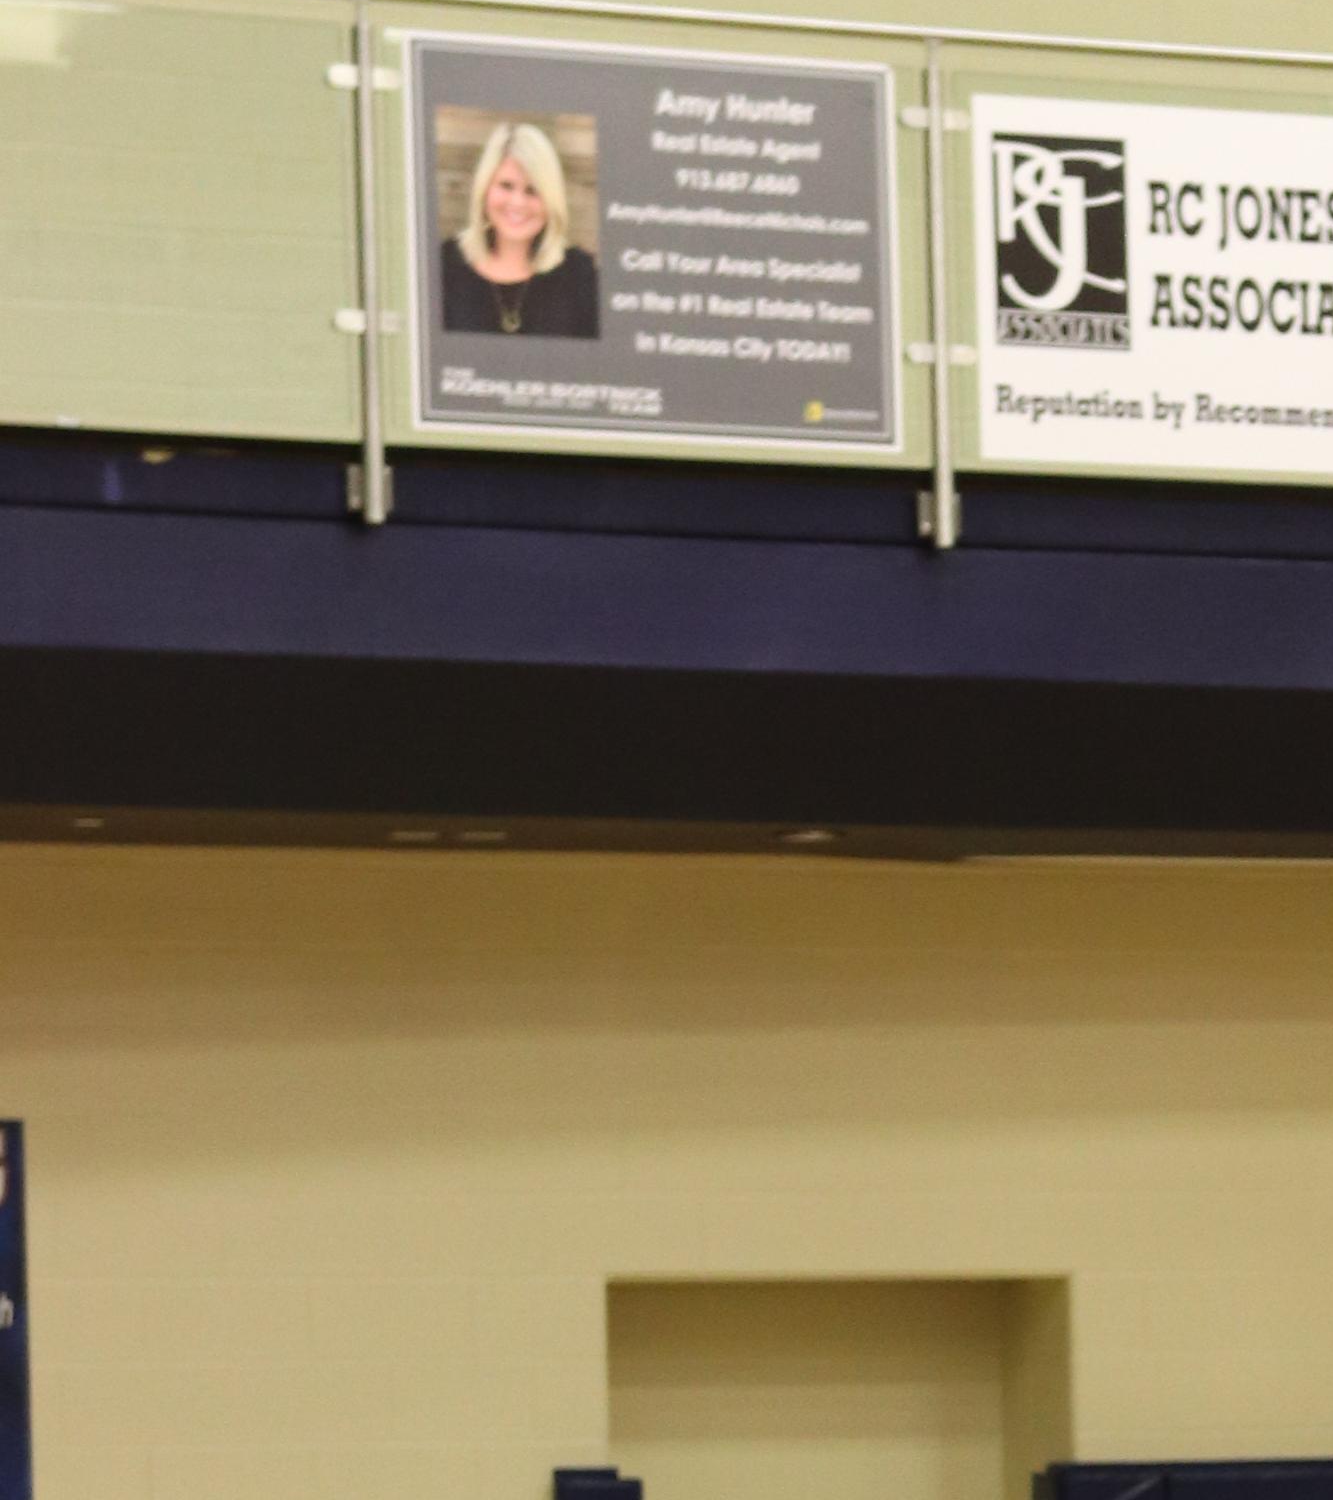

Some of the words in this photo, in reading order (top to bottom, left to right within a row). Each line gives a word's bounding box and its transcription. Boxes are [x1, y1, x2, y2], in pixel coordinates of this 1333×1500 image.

[654, 88, 721, 125] Amy
[725, 93, 817, 126] Hunter
[1148, 180, 1206, 237] RC
[995, 384, 1145, 424] Reputation
[1152, 392, 1186, 429] by
